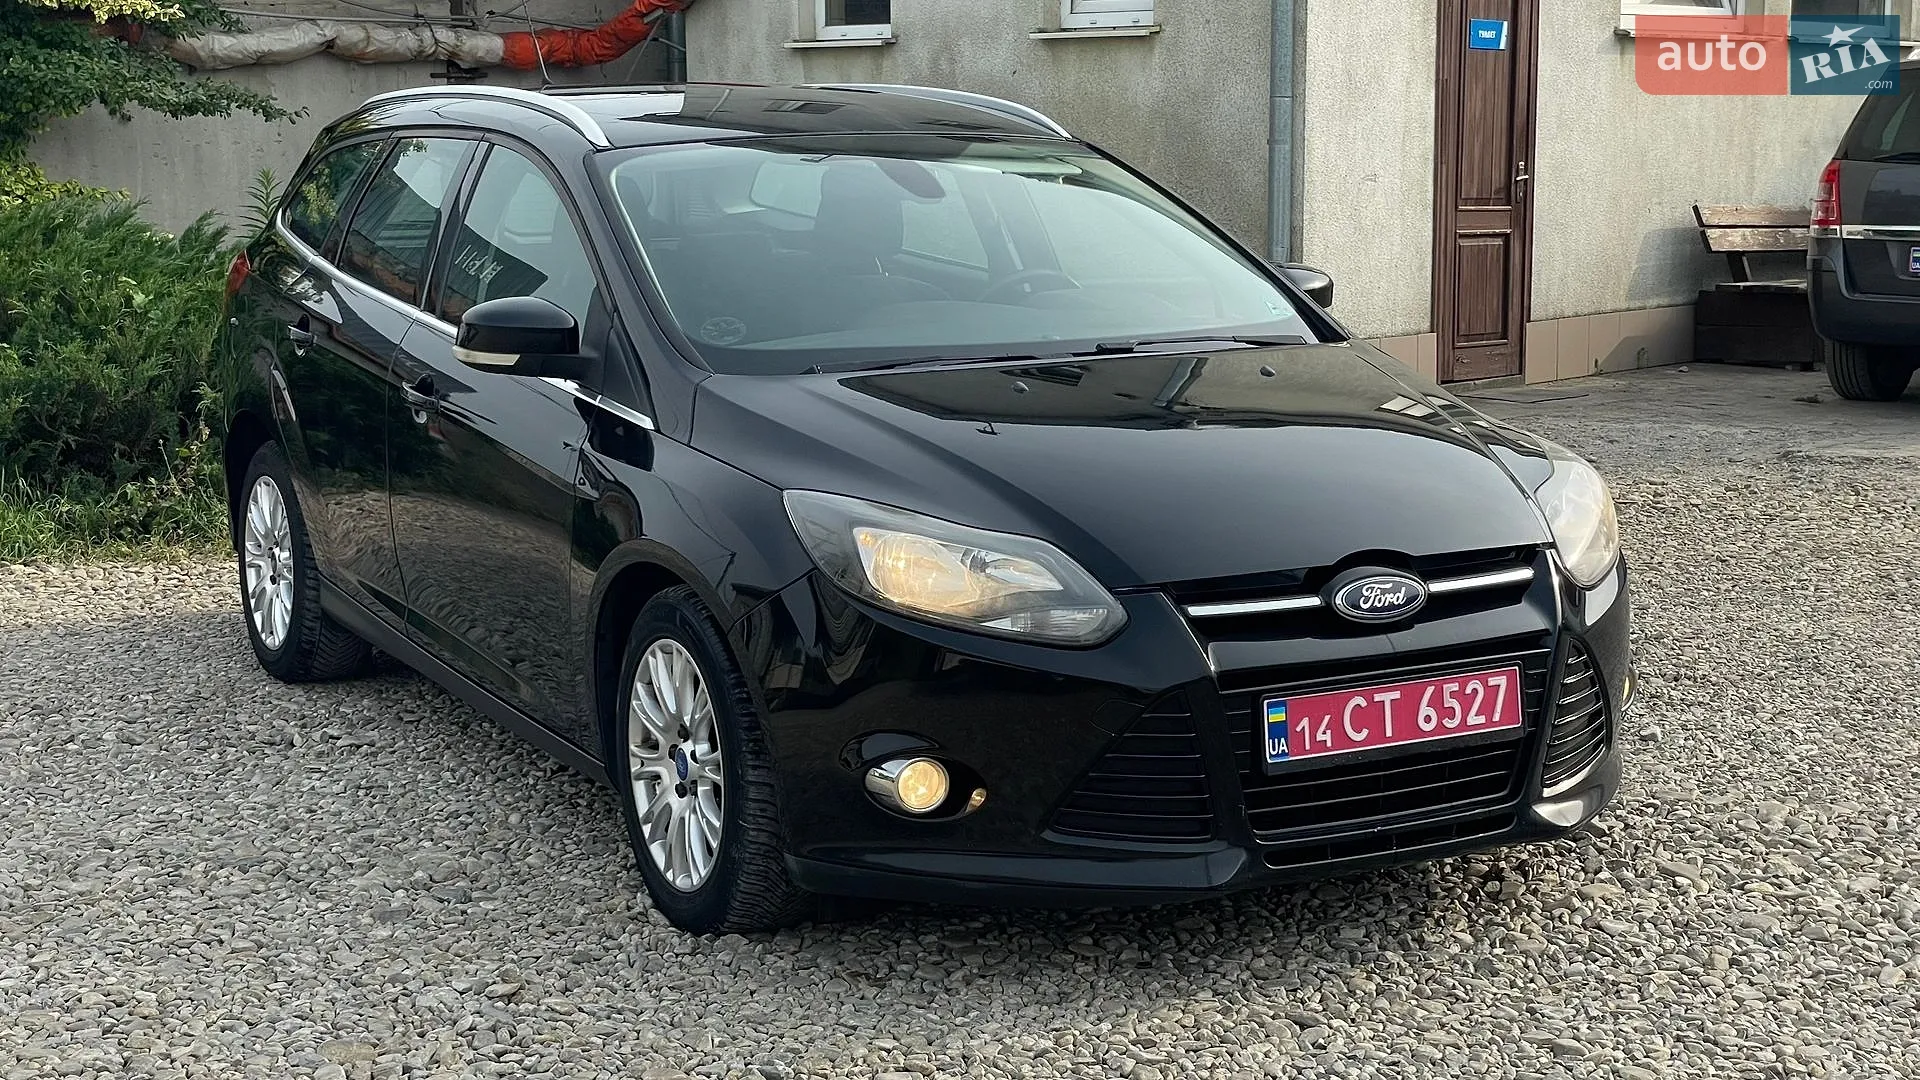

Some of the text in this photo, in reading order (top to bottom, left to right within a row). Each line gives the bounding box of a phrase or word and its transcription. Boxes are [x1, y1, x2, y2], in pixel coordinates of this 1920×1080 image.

[1360, 583, 1406, 609] Ford
[1295, 675, 1508, 750] 14 CT 6527
[1269, 738, 1288, 755] UA
